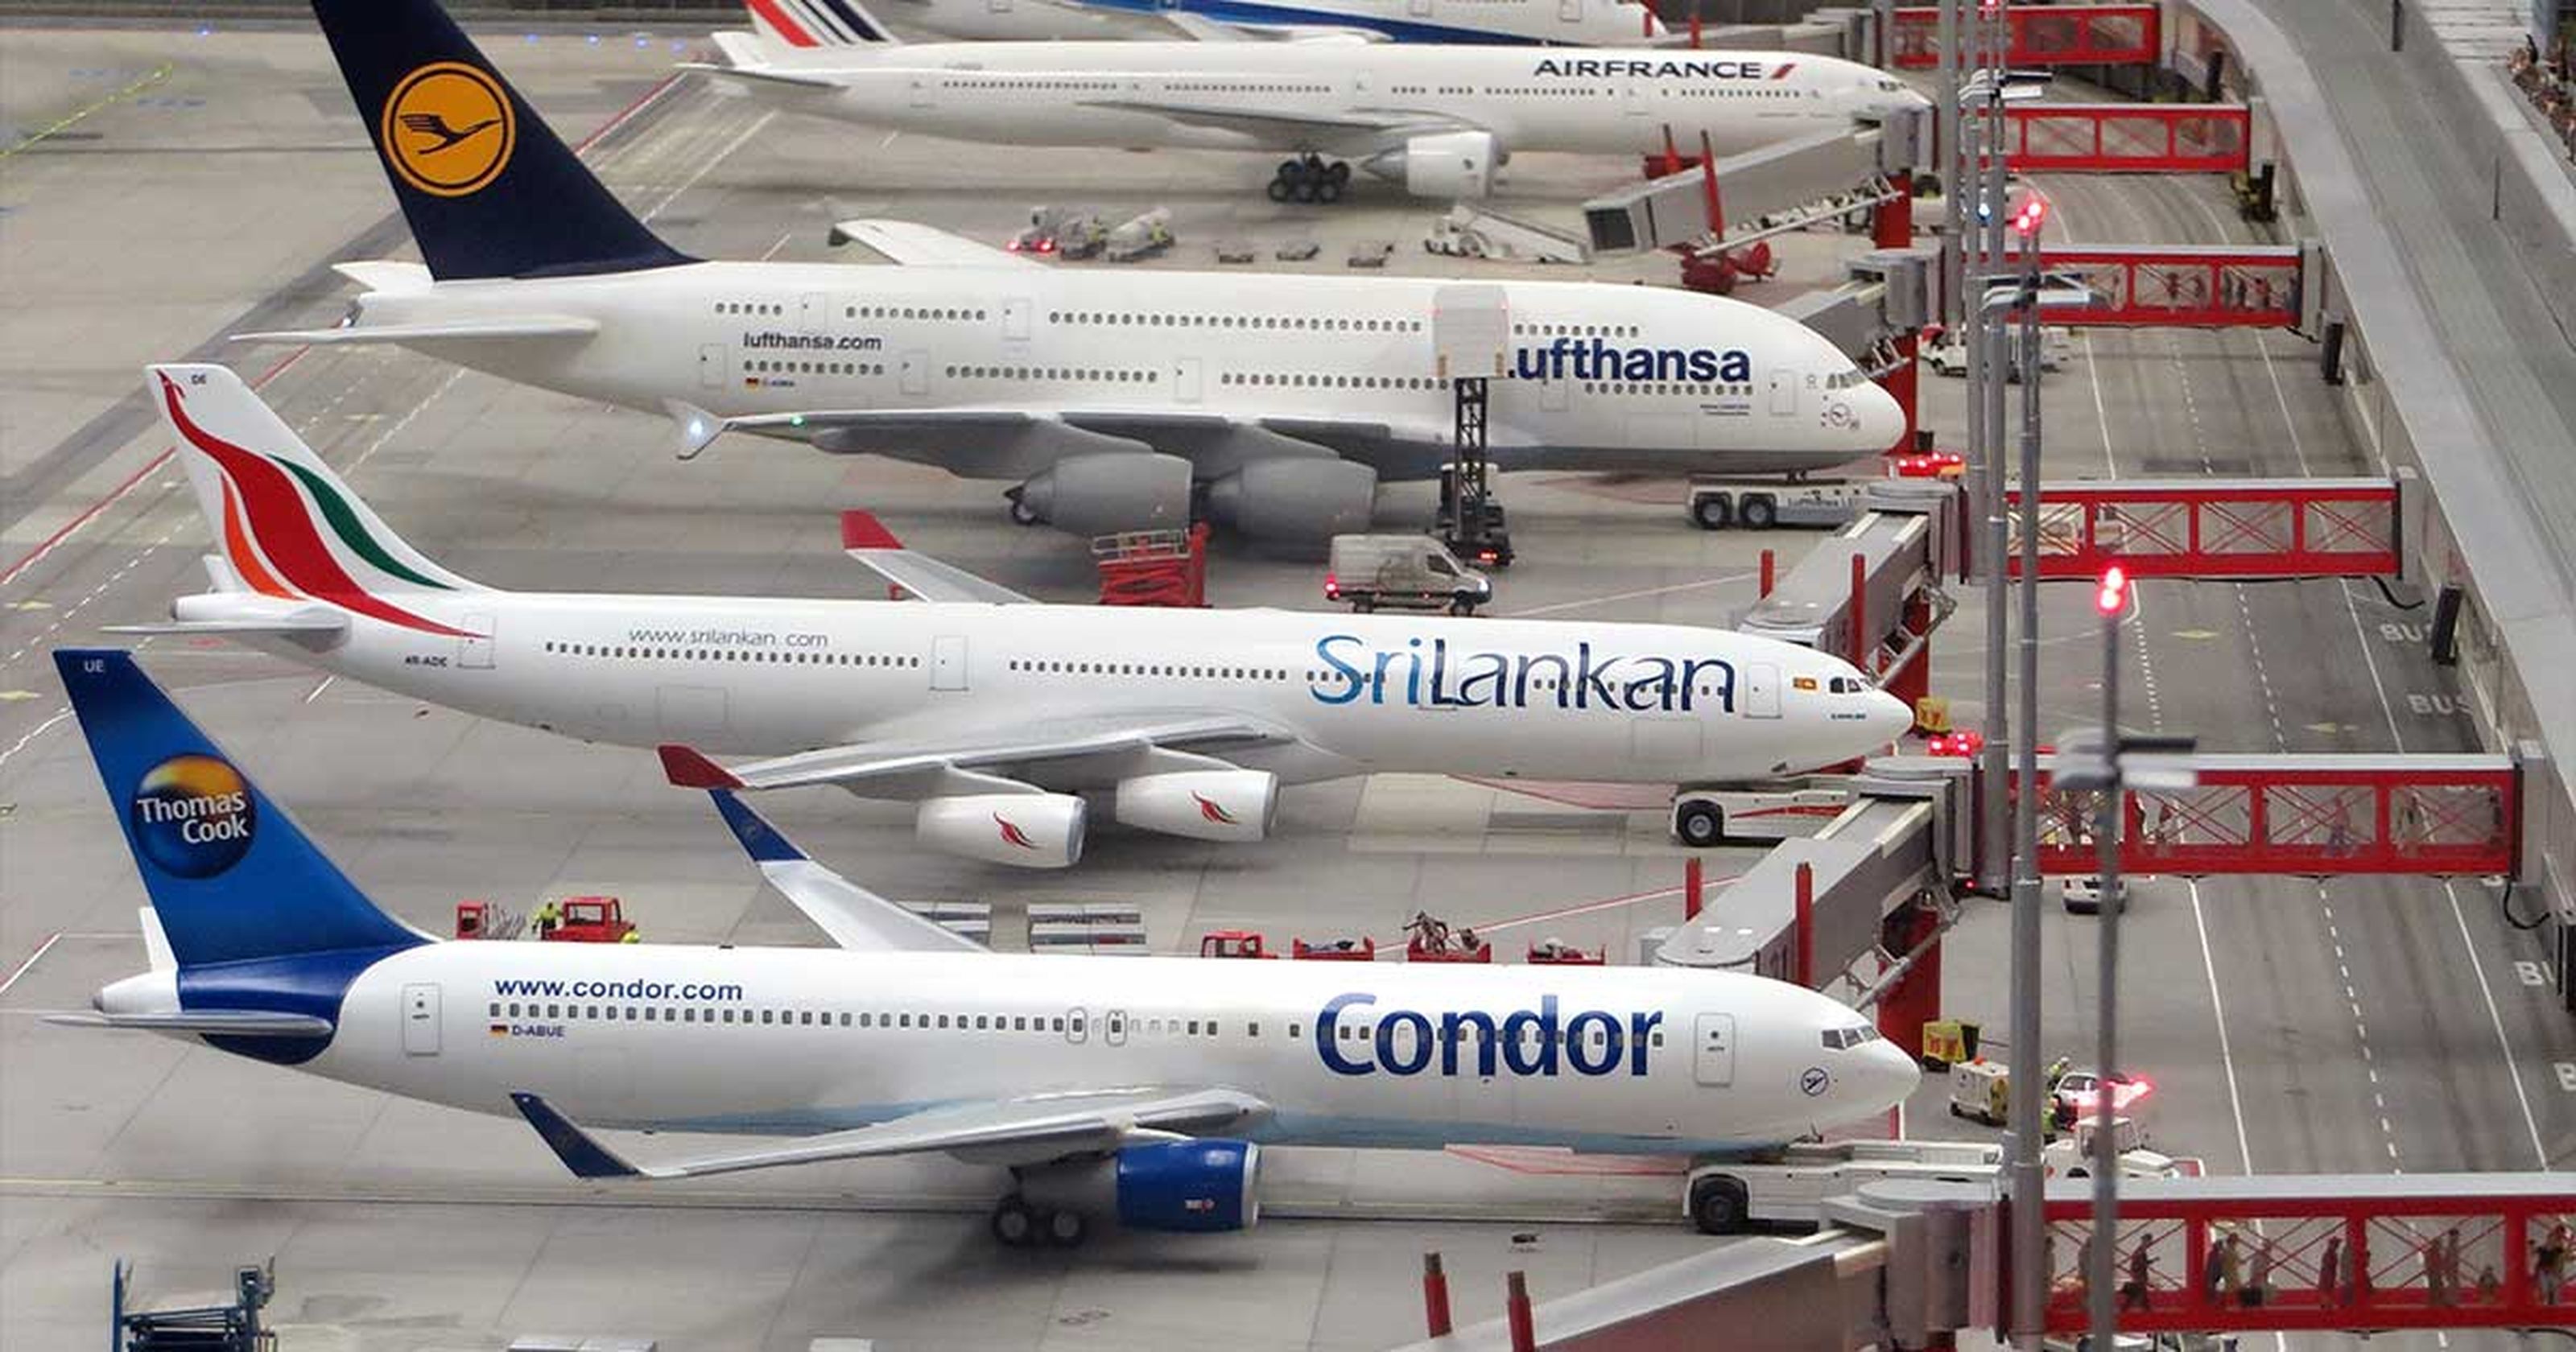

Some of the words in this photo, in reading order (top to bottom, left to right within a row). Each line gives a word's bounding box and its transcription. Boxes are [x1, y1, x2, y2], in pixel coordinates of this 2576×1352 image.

[1534, 60, 1761, 80] AIRFRANCE
[744, 332, 881, 351] lufthansa.com
[1508, 337, 1751, 382] ufthansa
[2380, 622, 2433, 641] BU
[84, 658, 104, 674] UE
[1310, 634, 1736, 713] SriLankan
[137, 791, 246, 823] Thomas
[183, 814, 250, 843] Cook
[495, 979, 743, 1001] www.condor.com
[511, 1024, 566, 1038] D-ABUE
[1316, 992, 1663, 1077] Condor
